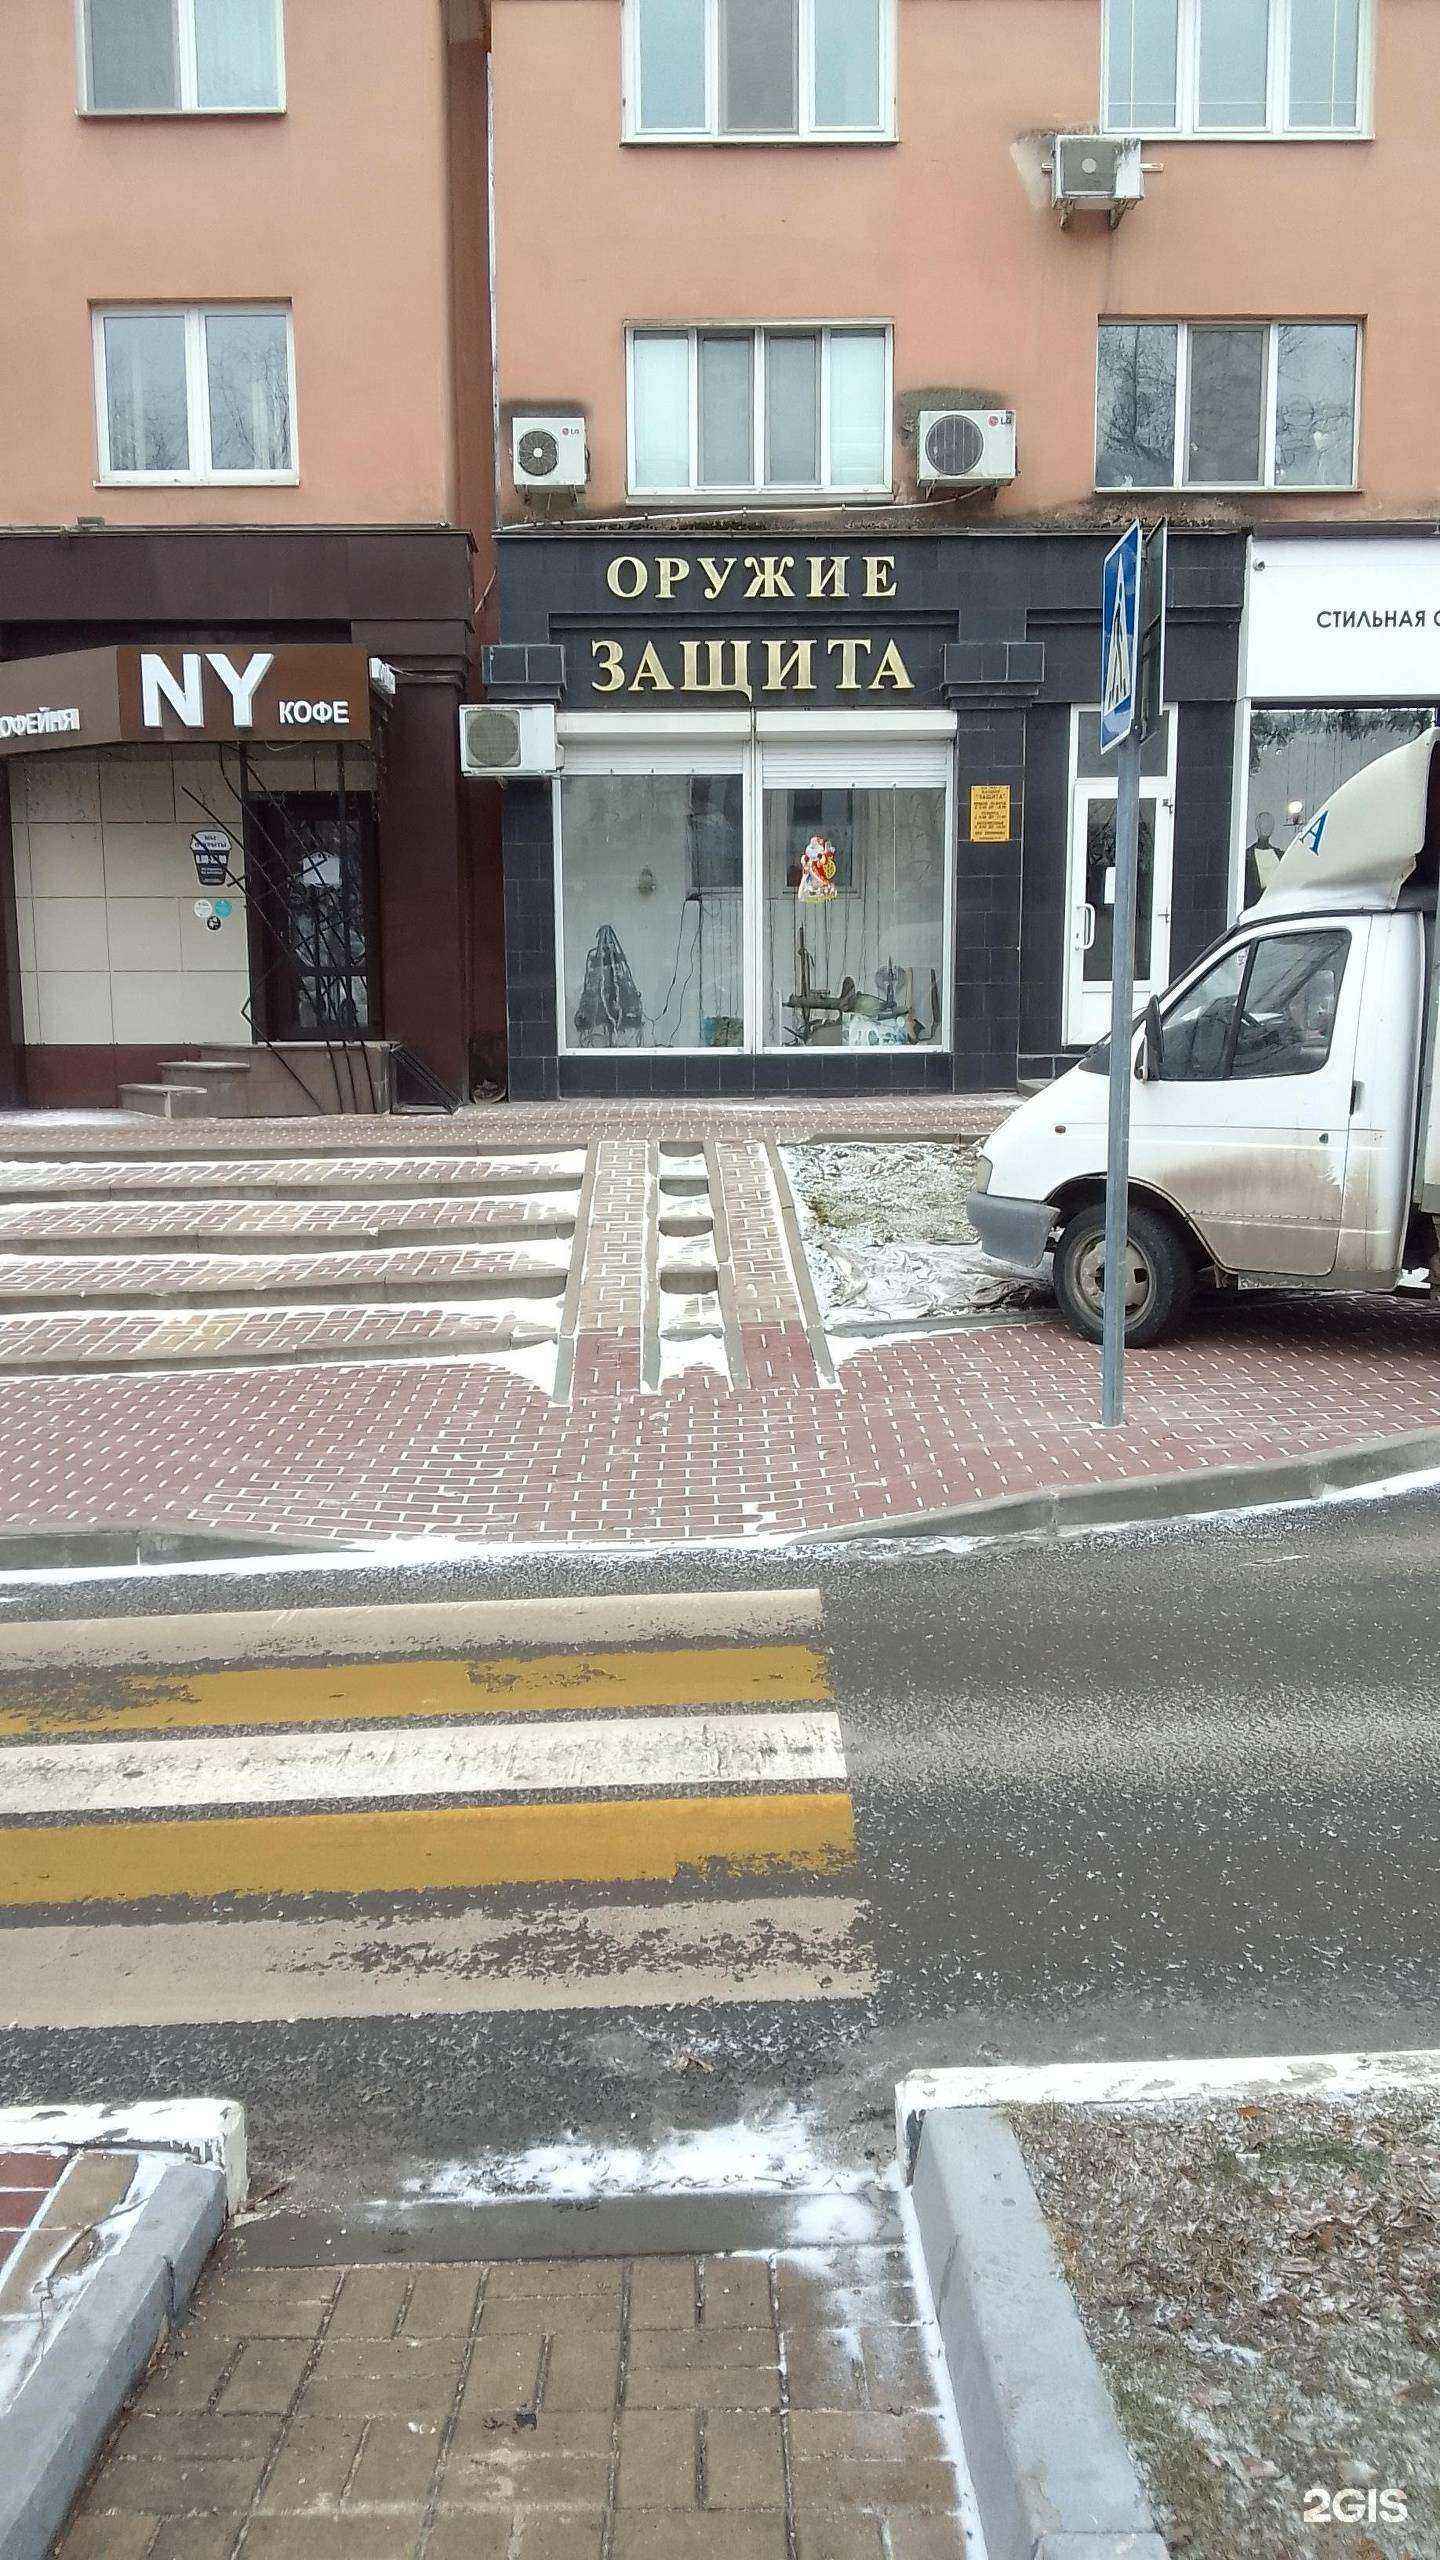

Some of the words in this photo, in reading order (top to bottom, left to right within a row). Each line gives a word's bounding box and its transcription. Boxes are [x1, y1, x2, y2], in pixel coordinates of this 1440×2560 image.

[1001, 415, 1012, 425] LG
[606, 555, 899, 600] ОРУЖИЕ
[1316, 609, 1427, 629] СТИЛЬНАЯ
[140, 653, 273, 729] NY
[278, 700, 350, 725] КОФЕ
[591, 638, 916, 703] ЗАЩИТА
